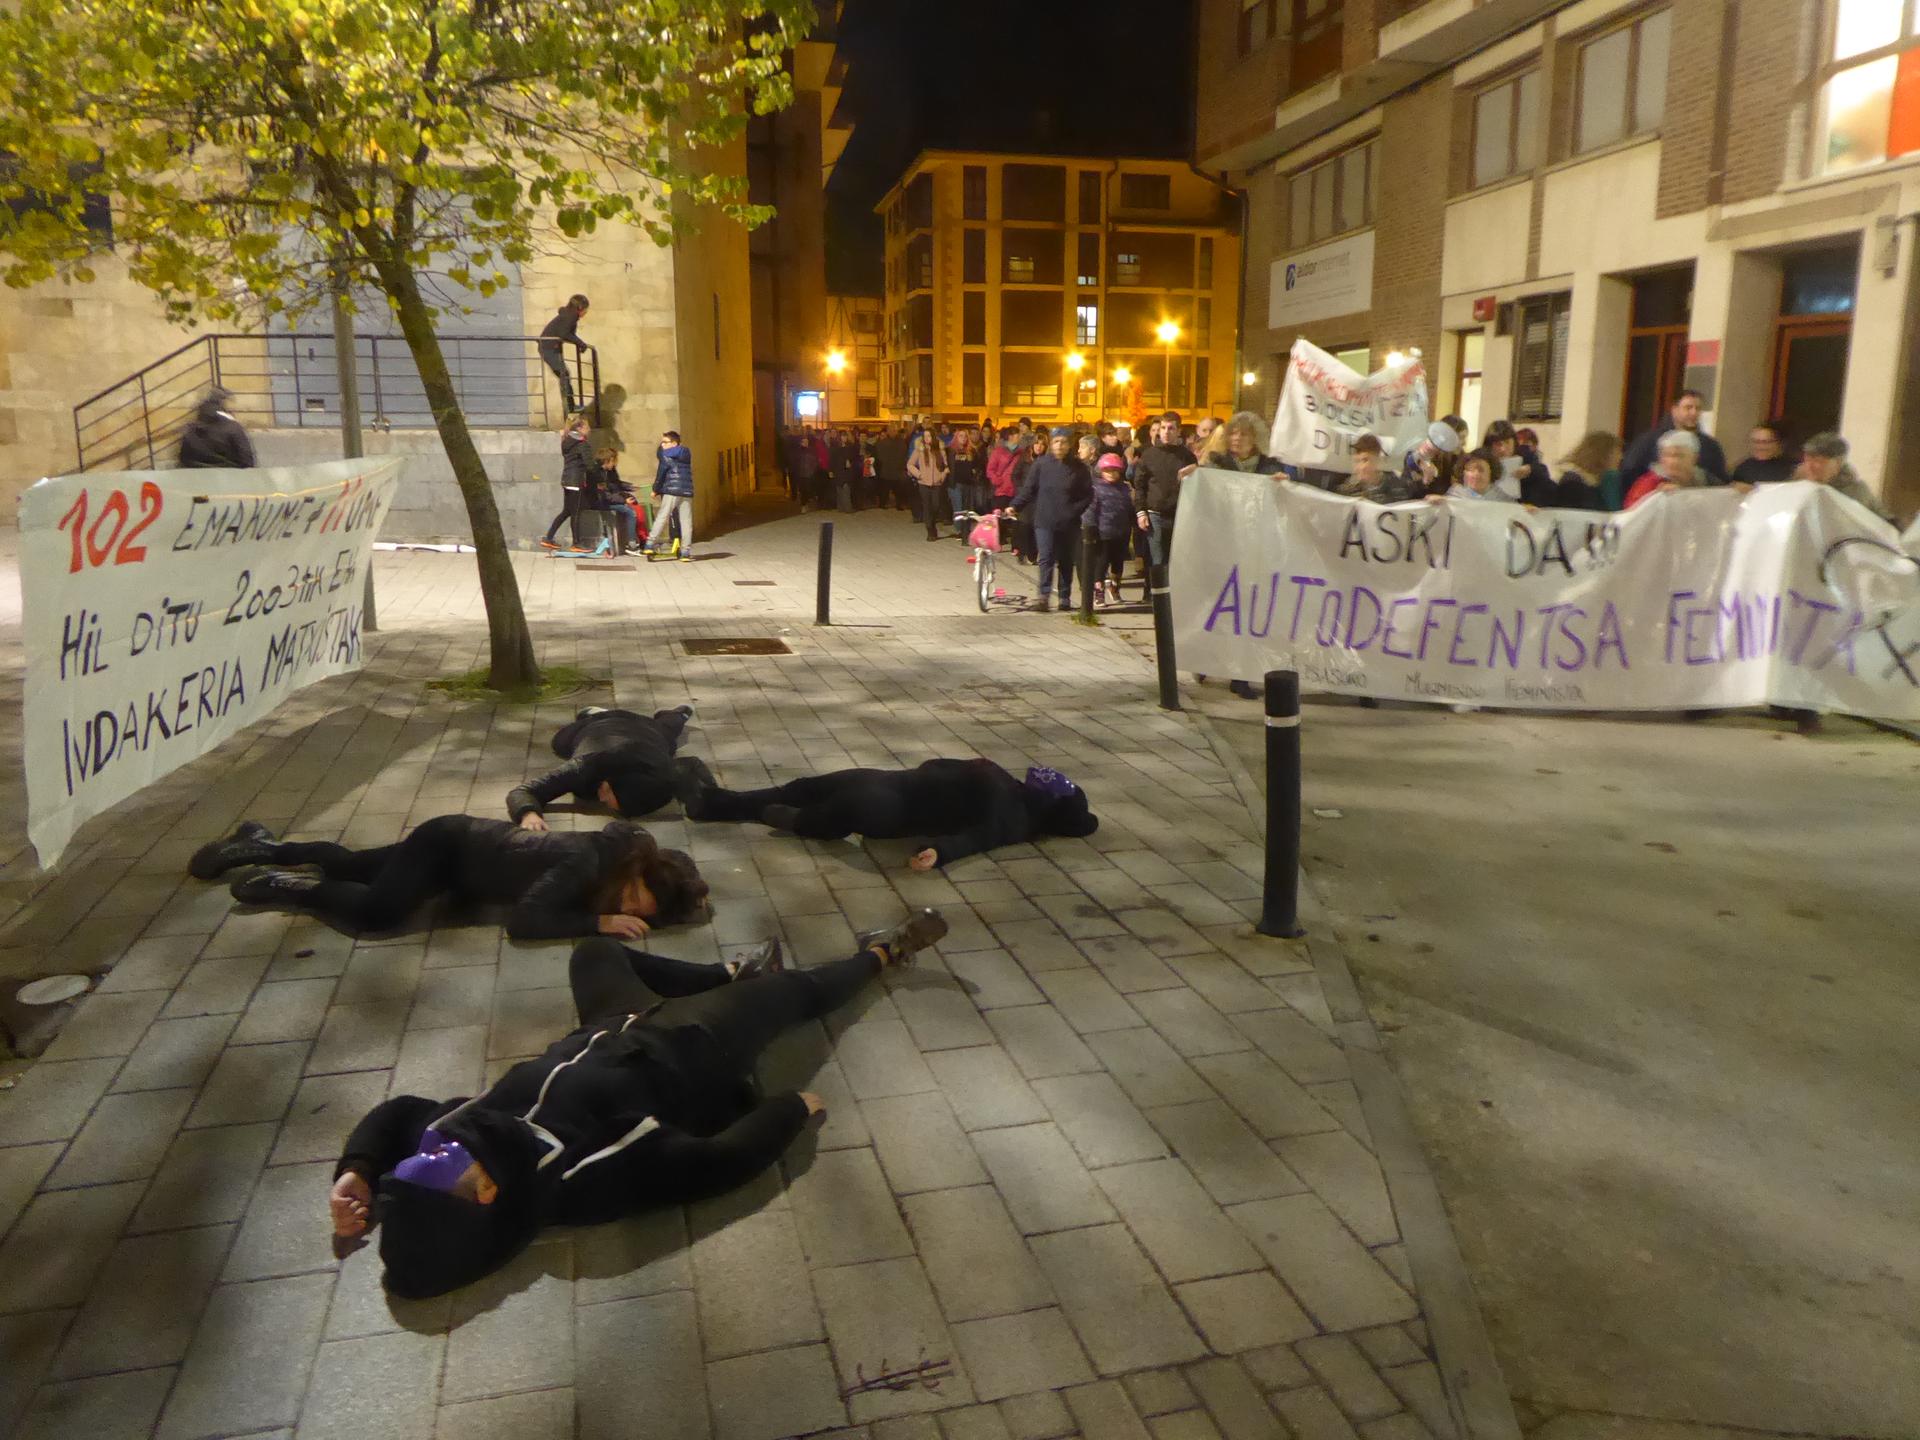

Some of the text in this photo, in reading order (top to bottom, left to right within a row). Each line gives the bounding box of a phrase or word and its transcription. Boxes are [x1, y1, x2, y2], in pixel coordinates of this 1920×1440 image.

[57, 481, 163, 574] 102
[1339, 505, 1456, 569] ASKI
[1204, 564, 1631, 670] AUTODEFENTSA
